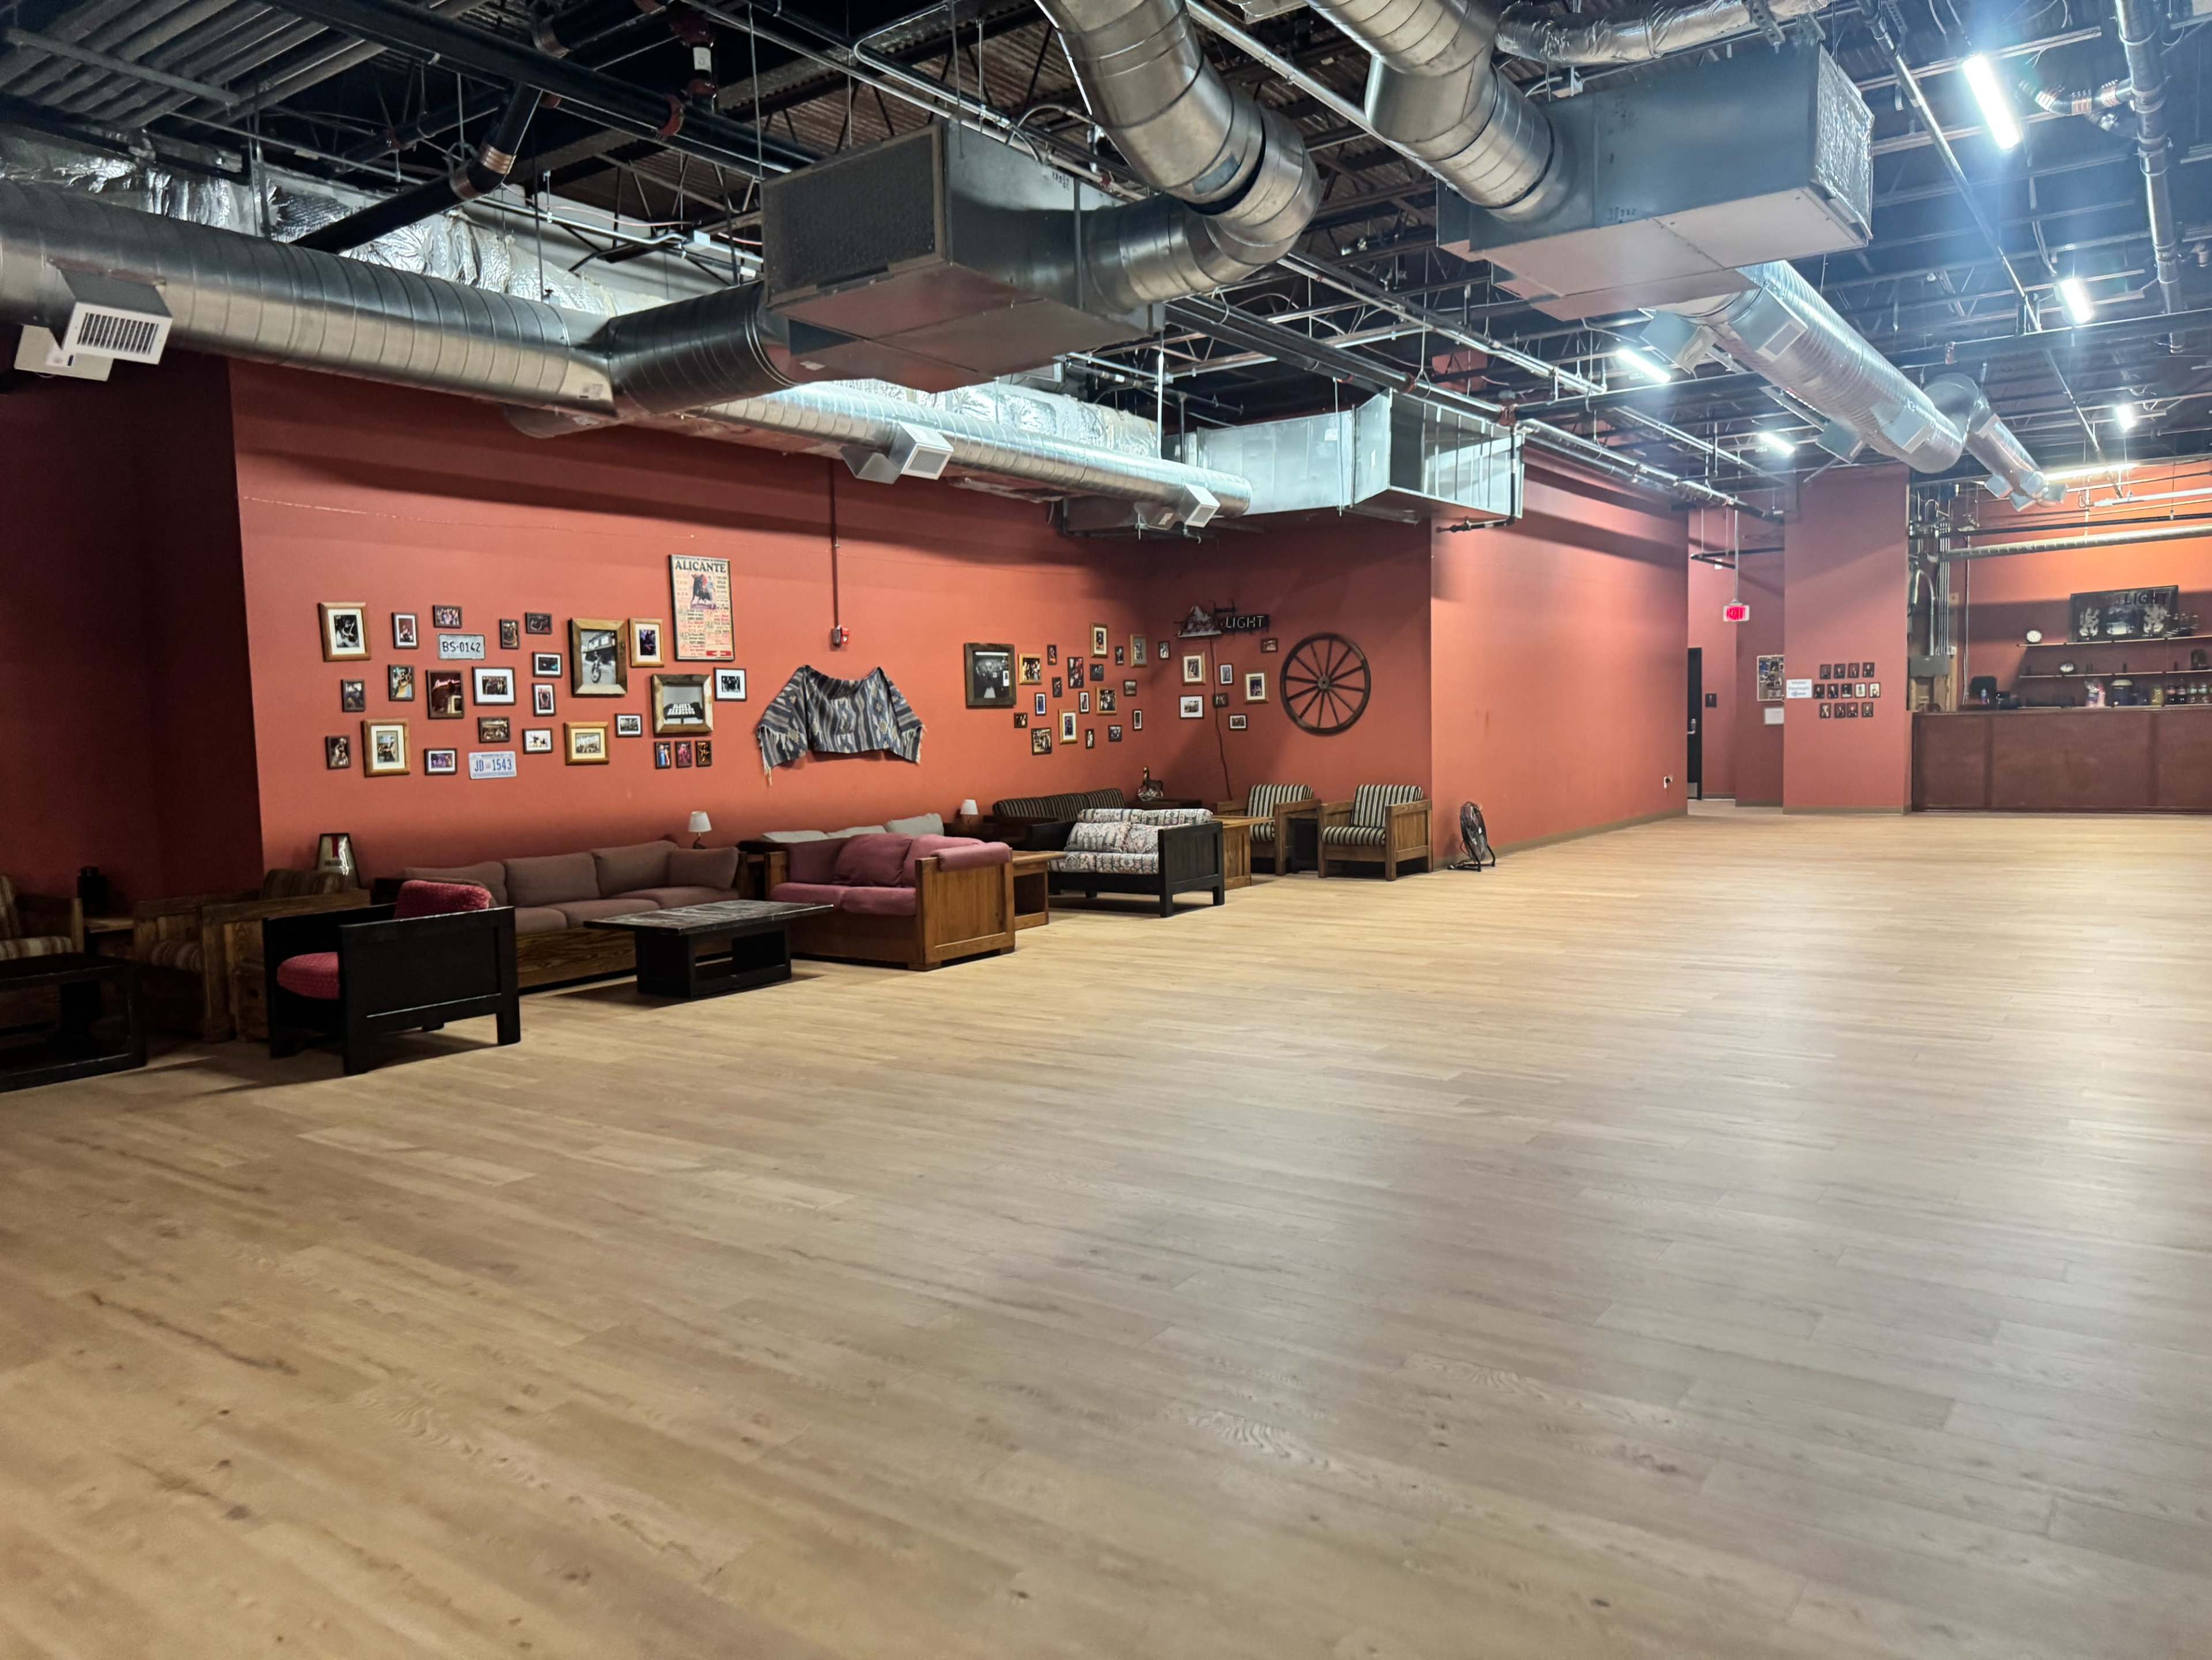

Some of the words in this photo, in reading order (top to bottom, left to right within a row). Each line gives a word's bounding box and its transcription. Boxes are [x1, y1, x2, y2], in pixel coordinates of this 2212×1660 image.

[675, 560, 726, 573] ALICANTE
[1225, 615, 1264, 629] LIGHT
[474, 759, 484, 772] JD
[492, 758, 513, 771] 1543
